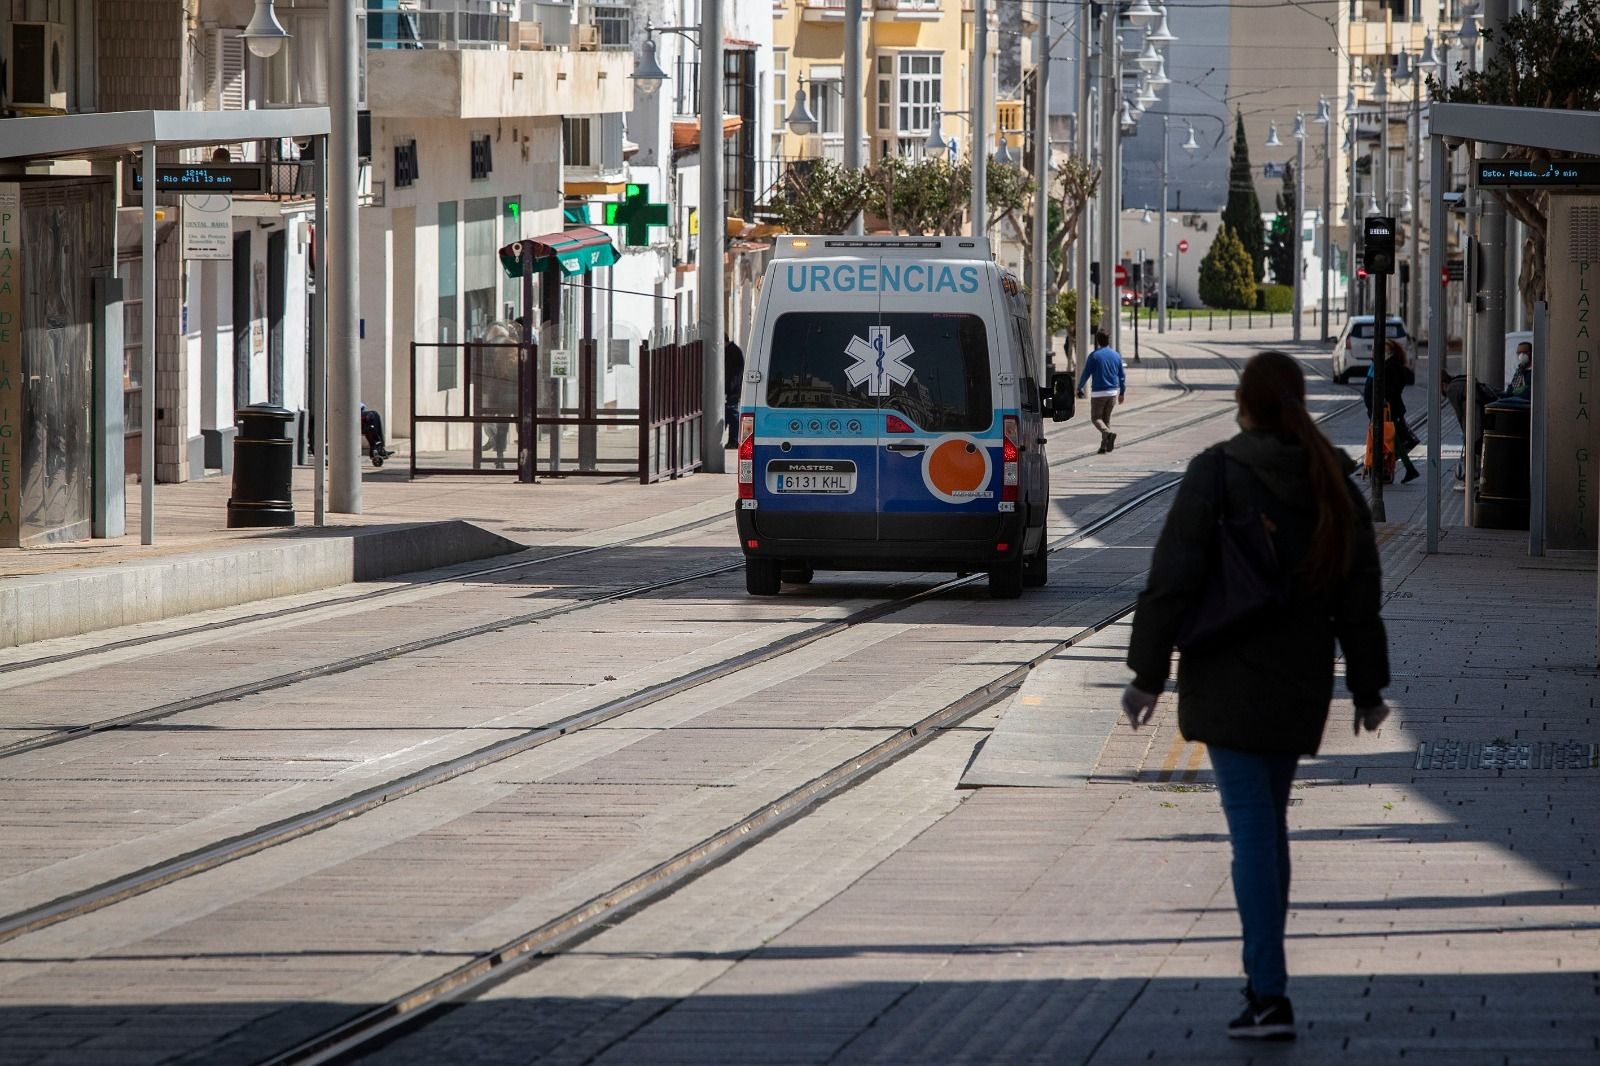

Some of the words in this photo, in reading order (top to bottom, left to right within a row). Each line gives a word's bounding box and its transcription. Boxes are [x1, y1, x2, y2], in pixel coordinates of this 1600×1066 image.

[0, 213, 12, 295] PLAZA
[787, 264, 979, 295] URGENCIAS
[1577, 263, 1589, 338] PLAZA
[0, 312, 12, 343] DE
[0, 361, 12, 391] LA
[1577, 350, 1589, 379] DE
[1576, 392, 1588, 420] LA
[0, 408, 12, 524] IGLESIA
[785, 476, 816, 488] 6131
[822, 476, 846, 488] KHL
